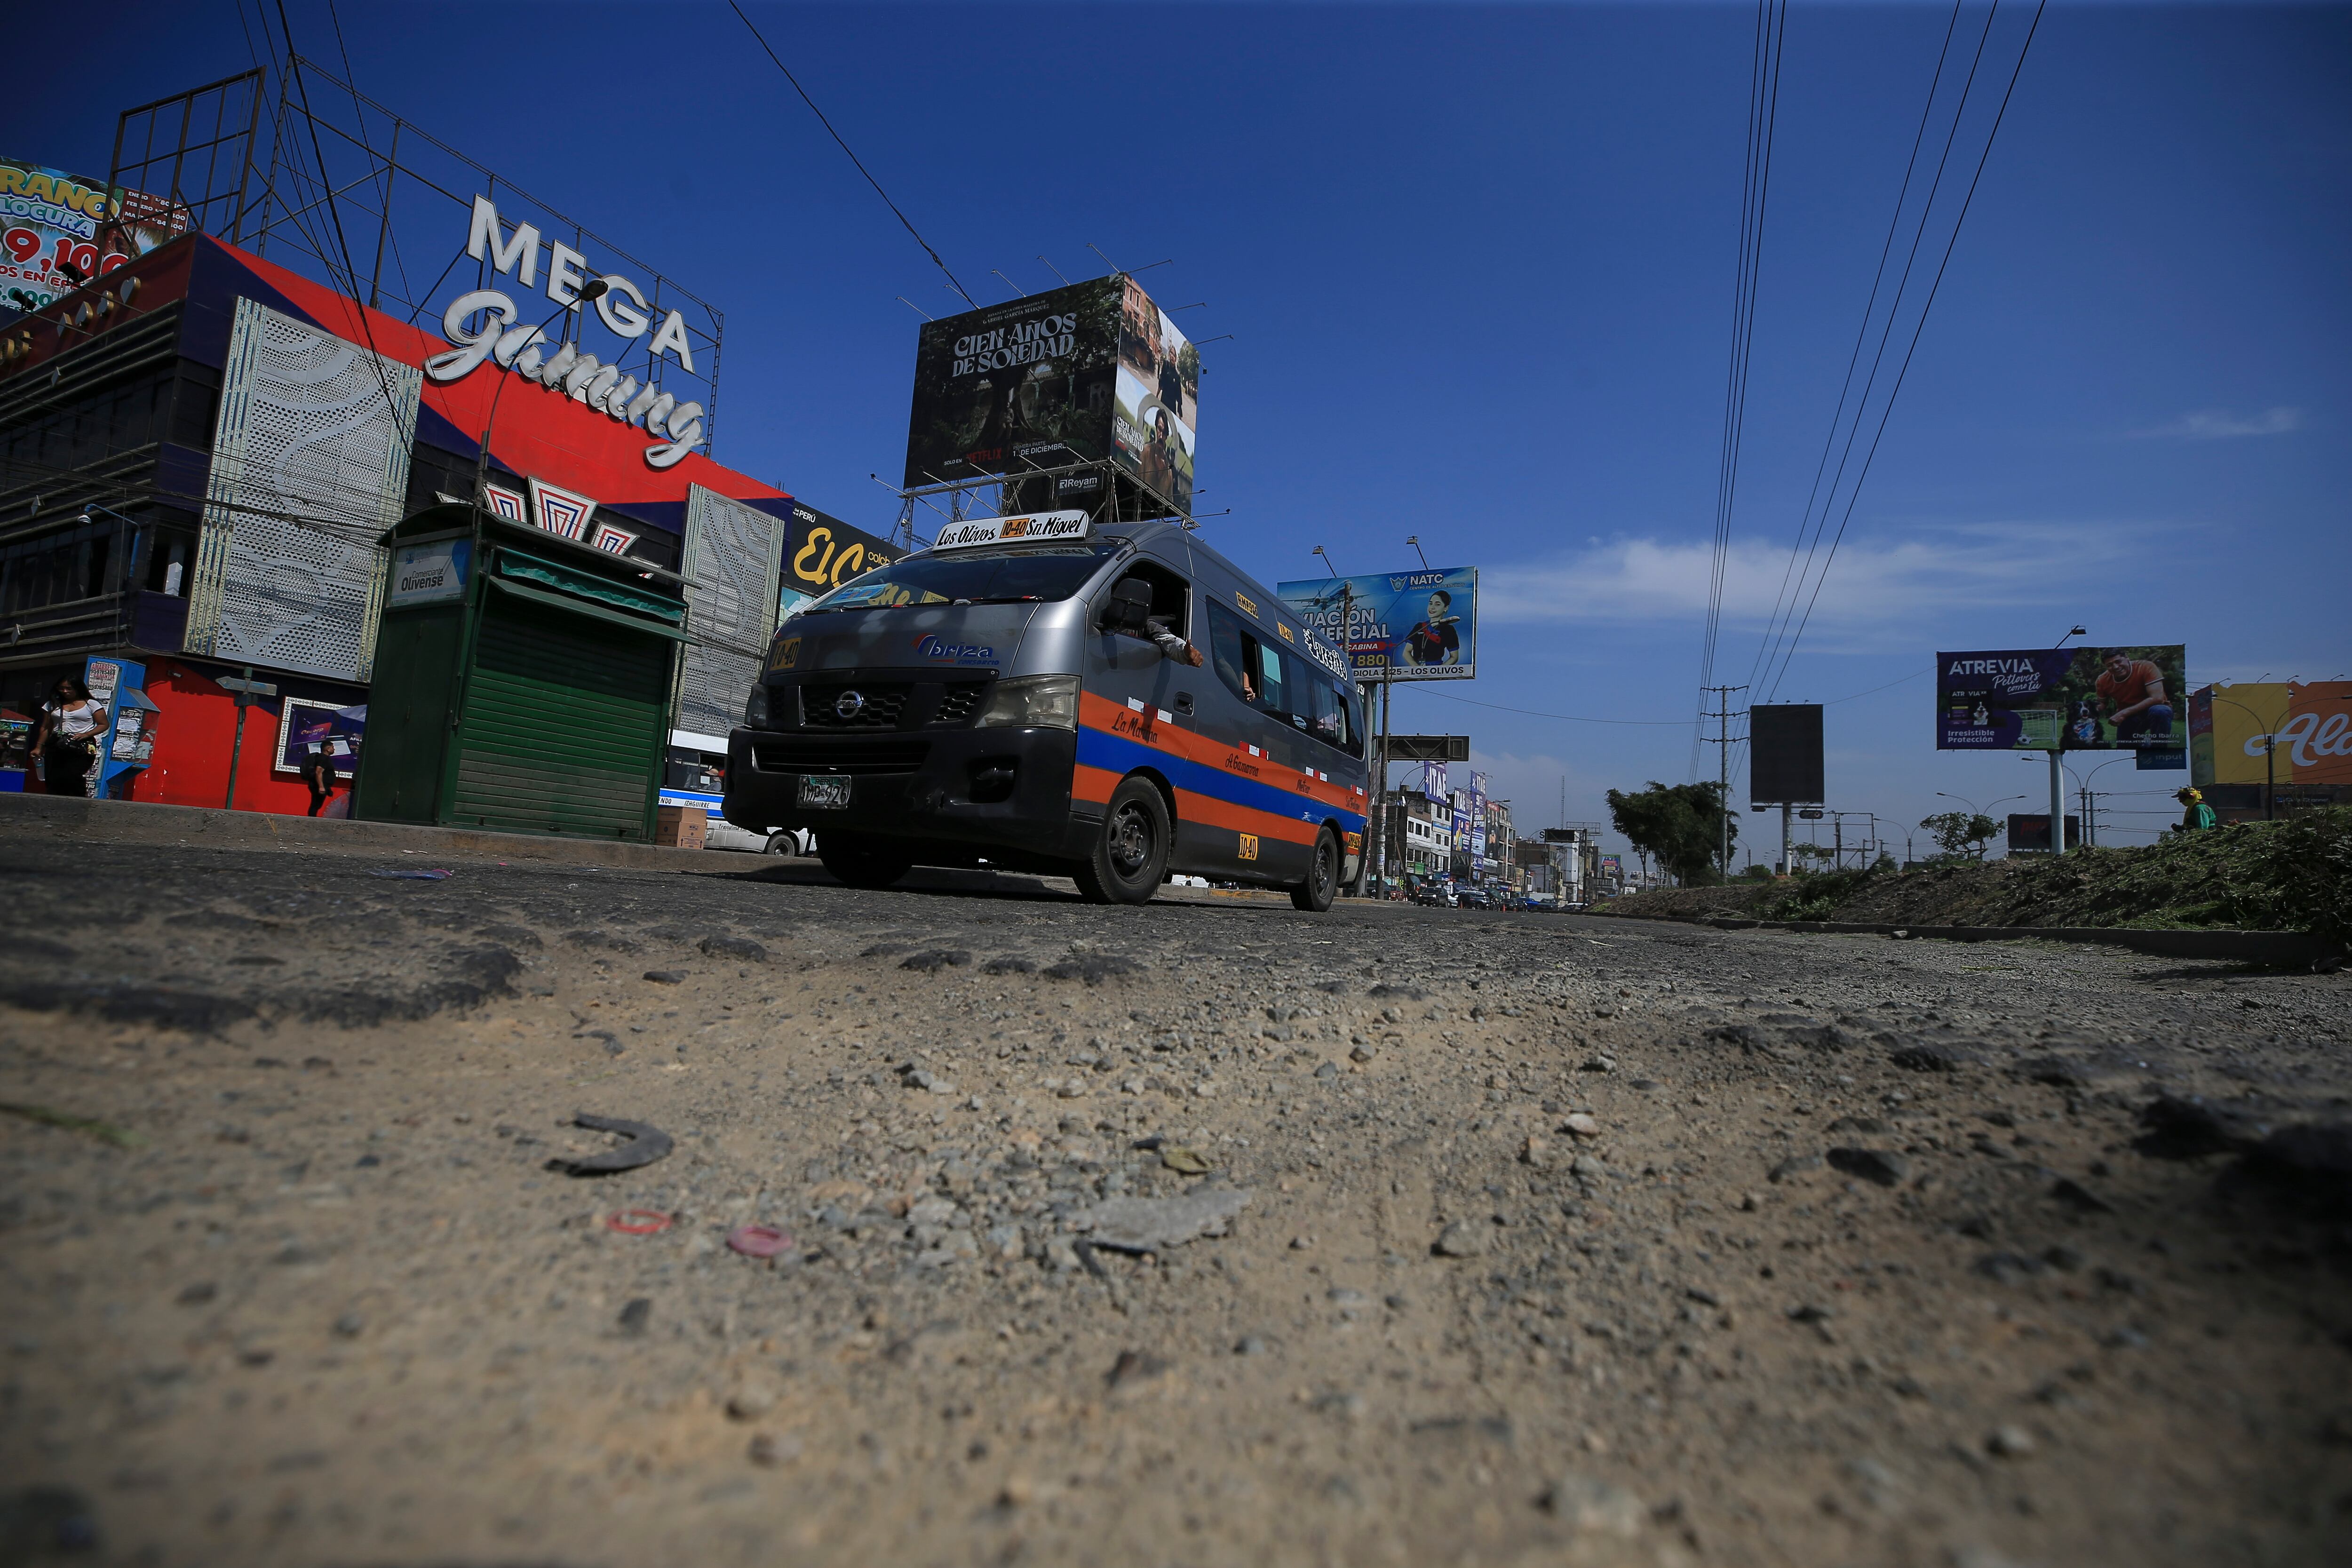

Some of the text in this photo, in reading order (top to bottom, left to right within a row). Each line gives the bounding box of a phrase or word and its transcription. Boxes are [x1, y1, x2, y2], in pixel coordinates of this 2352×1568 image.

[127, 201, 153, 211] FEBERO
[24, 271, 46, 282] EN
[466, 193, 695, 374] MEGA
[954, 313, 1077, 357] CIEN AÑOS
[952, 334, 1074, 377] DE SOLEDAD
[423, 289, 705, 468] Gaming
[1068, 478, 1097, 490] Reyam
[799, 510, 816, 523] PERÚ
[937, 528, 957, 546] Los
[958, 525, 996, 545] Olivos
[1002, 521, 1027, 536] 10-40
[794, 527, 835, 584] El
[412, 567, 444, 579] Comerciante
[1410, 574, 1443, 585] NATC
[401, 575, 444, 591] Olivense
[1358, 654, 1384, 666] 880
[1949, 658, 2034, 675] ATREVIA
[1992, 672, 2041, 689] Petlovers
[2007, 685, 2027, 693] como
[1112, 711, 1127, 732] La
[1430, 766, 1446, 801] ITAE
[684, 800, 710, 809] IZAGUIRRE
[1454, 789, 1466, 812] ITAE
[1240, 836, 1256, 859] 10-40
